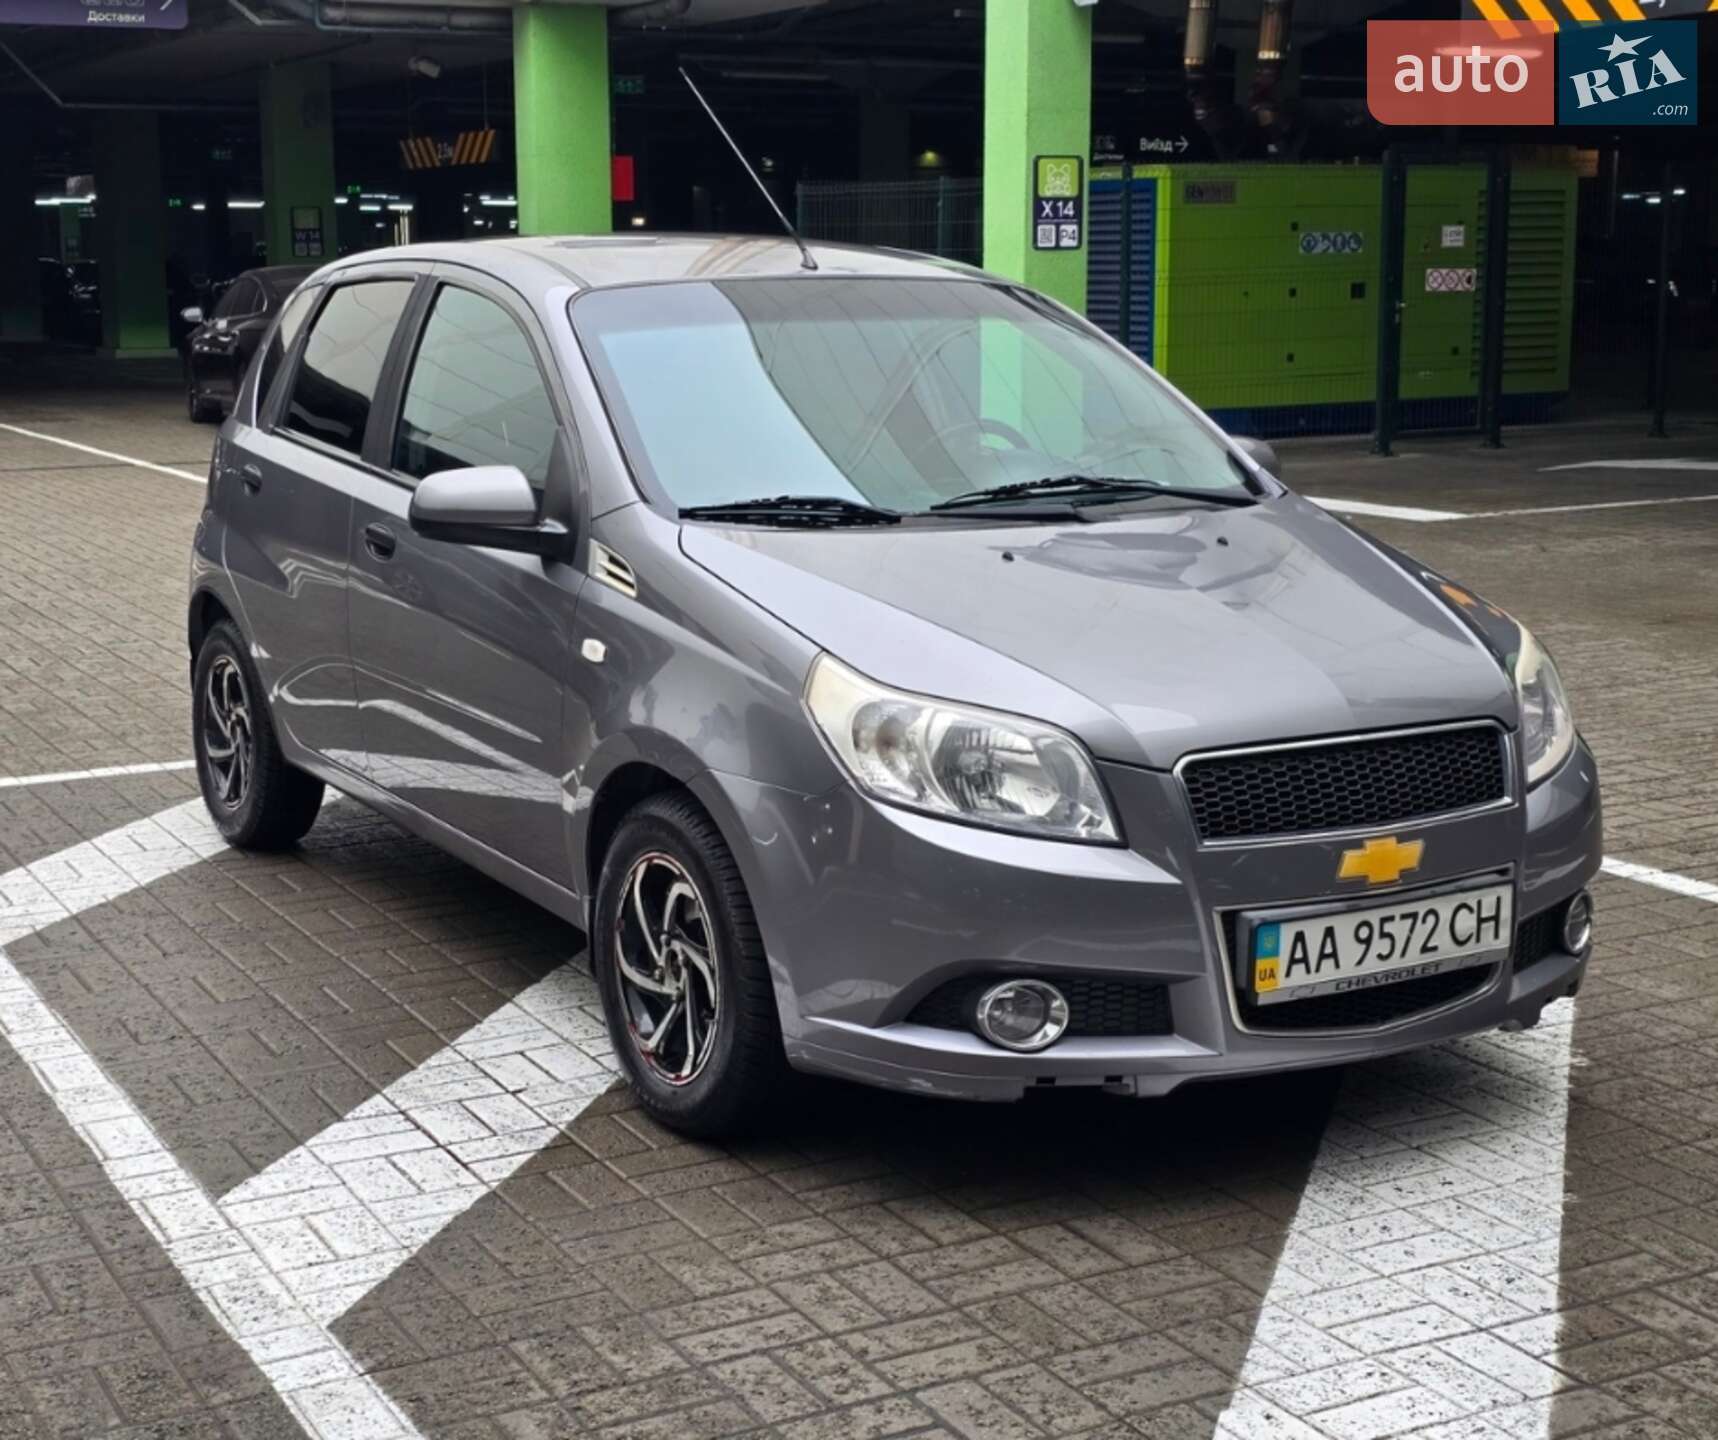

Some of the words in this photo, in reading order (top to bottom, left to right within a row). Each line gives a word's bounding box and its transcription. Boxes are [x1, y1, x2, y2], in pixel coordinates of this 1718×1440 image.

[87, 10, 145, 23] Доставки
[1139, 136, 1173, 153] Виїзд
[1041, 200, 1054, 218] X
[1056, 200, 1075, 218] 14
[1285, 926, 1341, 979] AA
[1353, 907, 1441, 967] 9572
[1449, 895, 1501, 947] CH
[1258, 969, 1277, 982] UA
[1335, 963, 1443, 991] CHEVROLET
